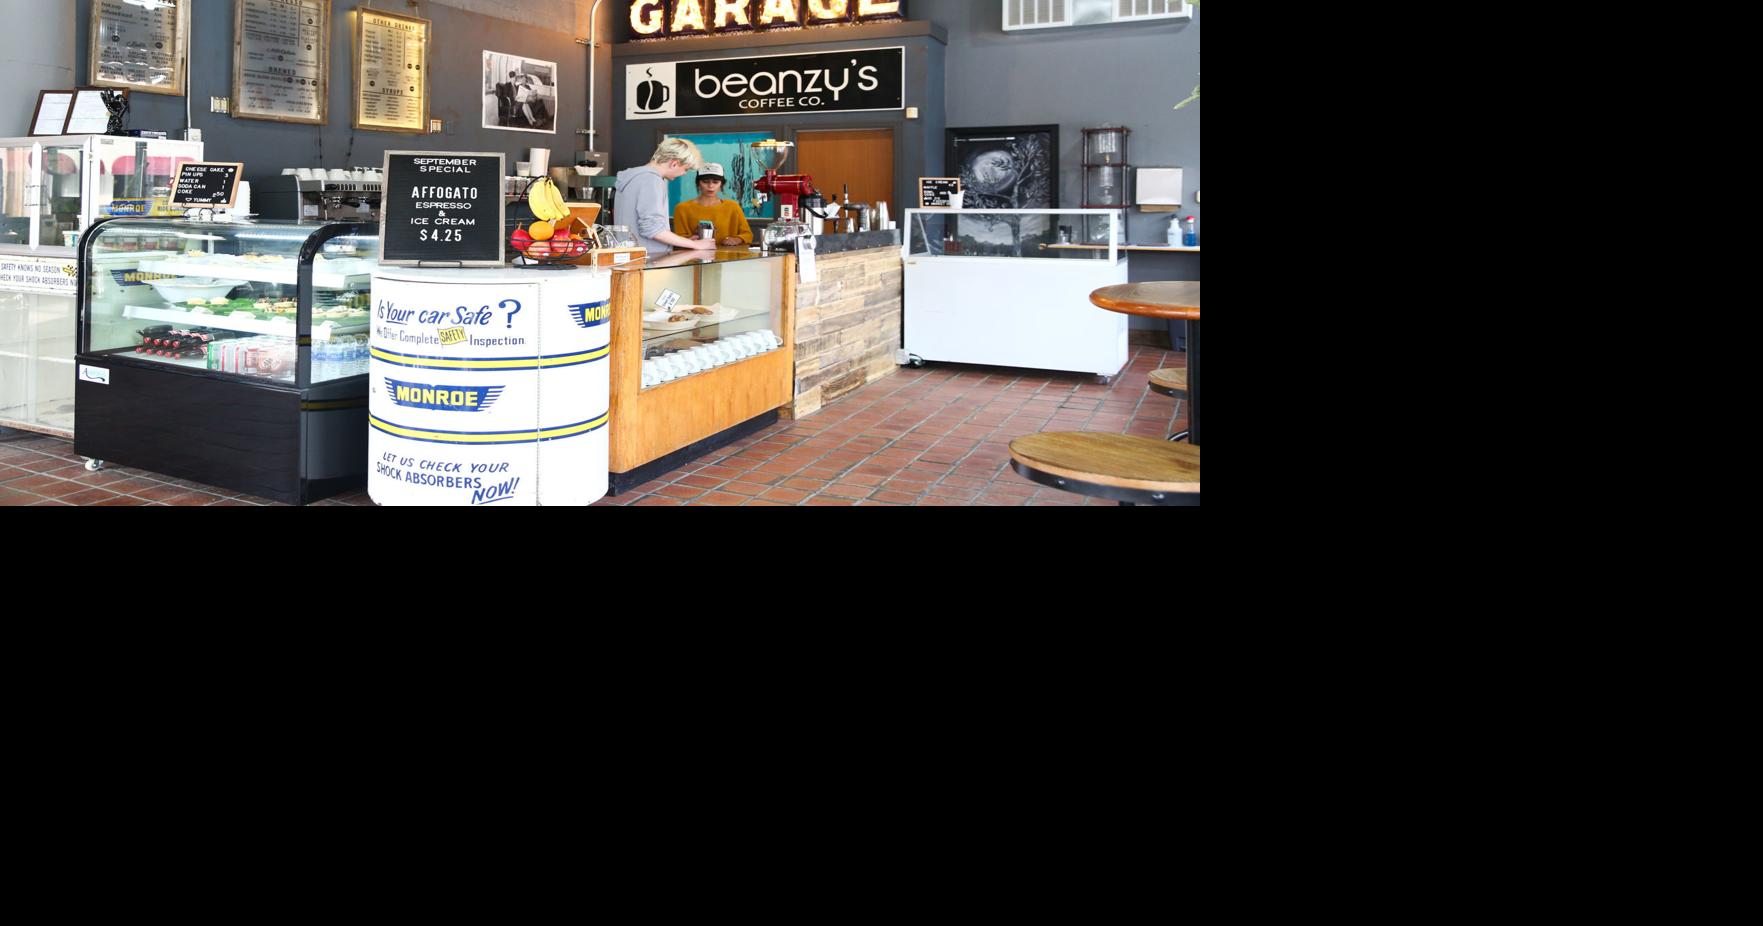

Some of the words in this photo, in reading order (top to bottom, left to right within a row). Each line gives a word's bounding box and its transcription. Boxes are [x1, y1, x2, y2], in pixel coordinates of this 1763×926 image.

[694, 58, 879, 101] beanzy's
[739, 96, 795, 109] COFFEE
[798, 95, 825, 108] CO.
[411, 185, 478, 200] AFFOGATO
[415, 201, 472, 210] ESPRESSO
[410, 217, 430, 225] ICE
[434, 217, 476, 226] CREAM
[1, 263, 16, 271] SAFETY
[18, 264, 33, 272] KNOWS
[43, 265, 60, 273] SEASON
[0, 274, 11, 282] HECK
[25, 276, 40, 284] SHOCK
[42, 276, 69, 285] ABSORBERS
[377, 299, 385, 319] Is
[386, 301, 415, 322] Your
[418, 310, 450, 325] car
[450, 305, 493, 326] Safe
[498, 299, 521, 329] ?
[400, 330, 439, 345] Complete
[440, 328, 465, 343] SAFETY
[469, 335, 524, 348] Inspection
[396, 384, 479, 407] MONROE
[383, 451, 396, 463] LET
[400, 456, 414, 467] US
[420, 459, 462, 473] CHECK
[471, 462, 509, 473] YOUR
[376, 461, 402, 480] SHOCK
[405, 471, 482, 489] ABSORBERS
[473, 477, 522, 504] NOW!
